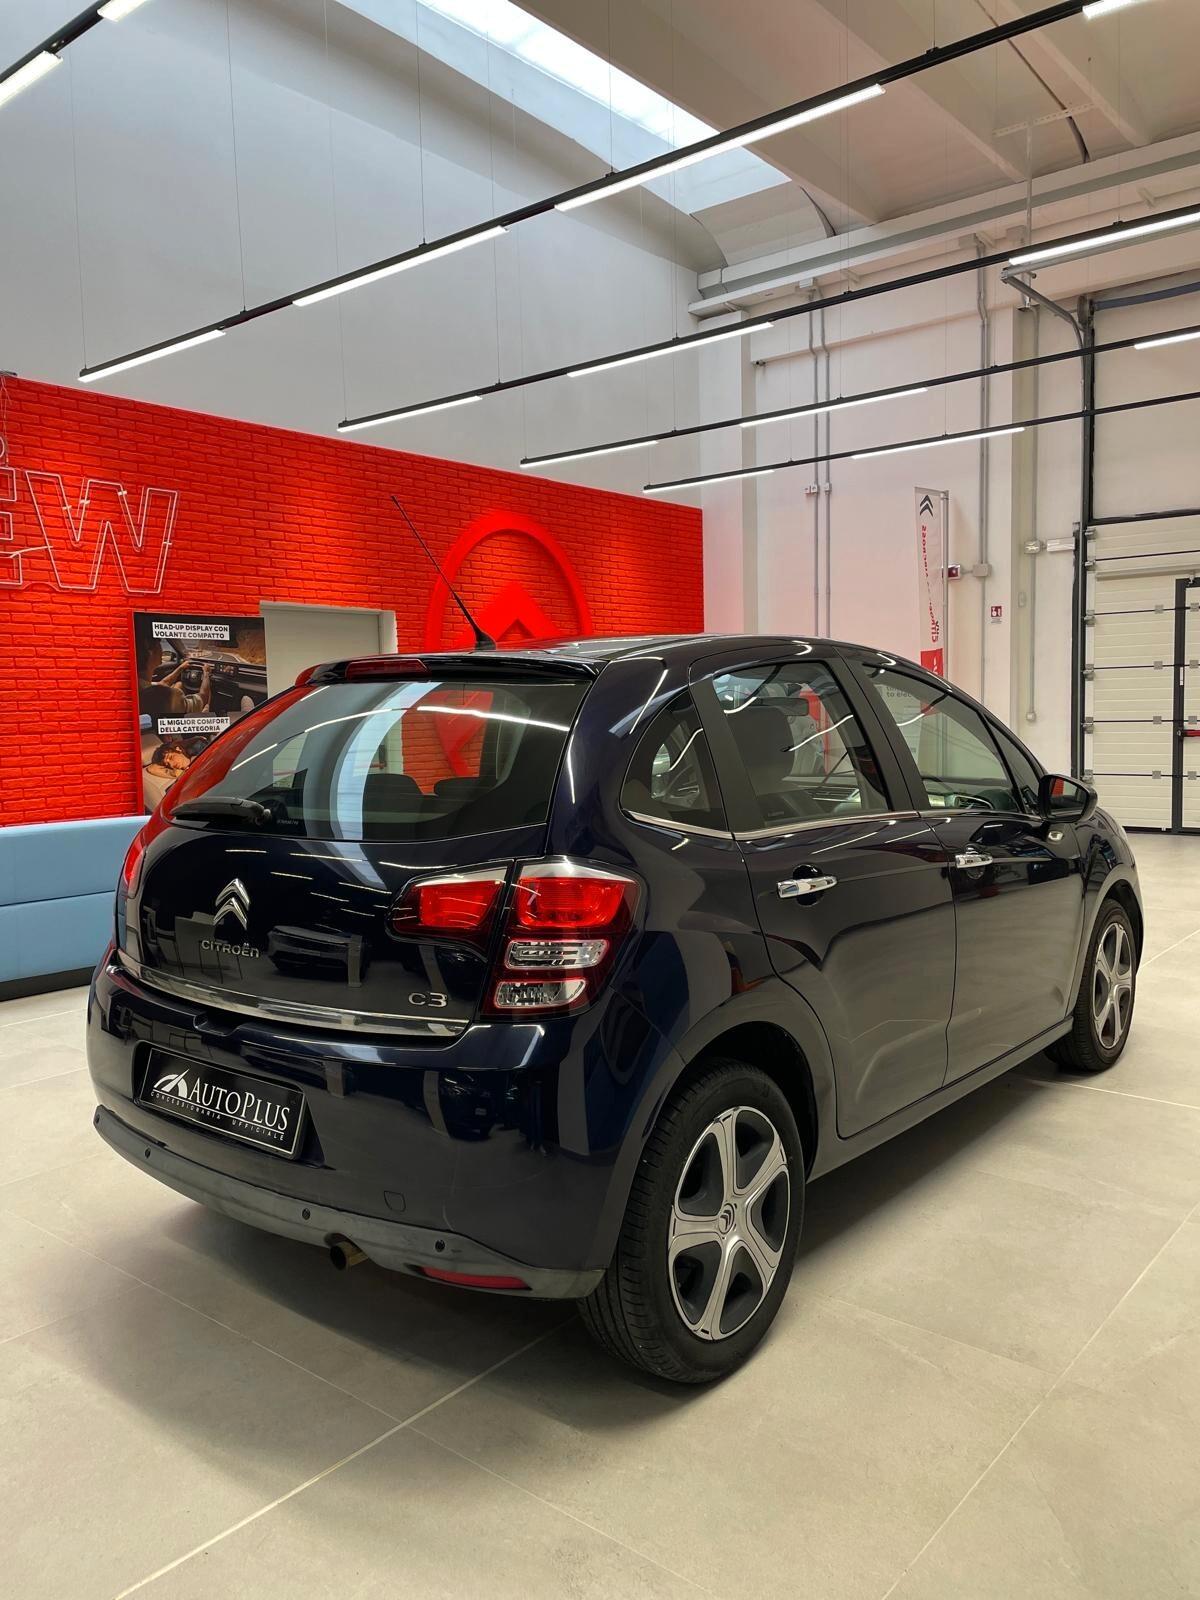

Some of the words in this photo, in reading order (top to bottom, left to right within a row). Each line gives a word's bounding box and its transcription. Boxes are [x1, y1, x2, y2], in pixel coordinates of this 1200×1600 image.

[408, 992, 448, 1008] C3
[150, 1091, 221, 1120] CONCESSIONARIA
[232, 1119, 285, 1141] UFFICIALE
